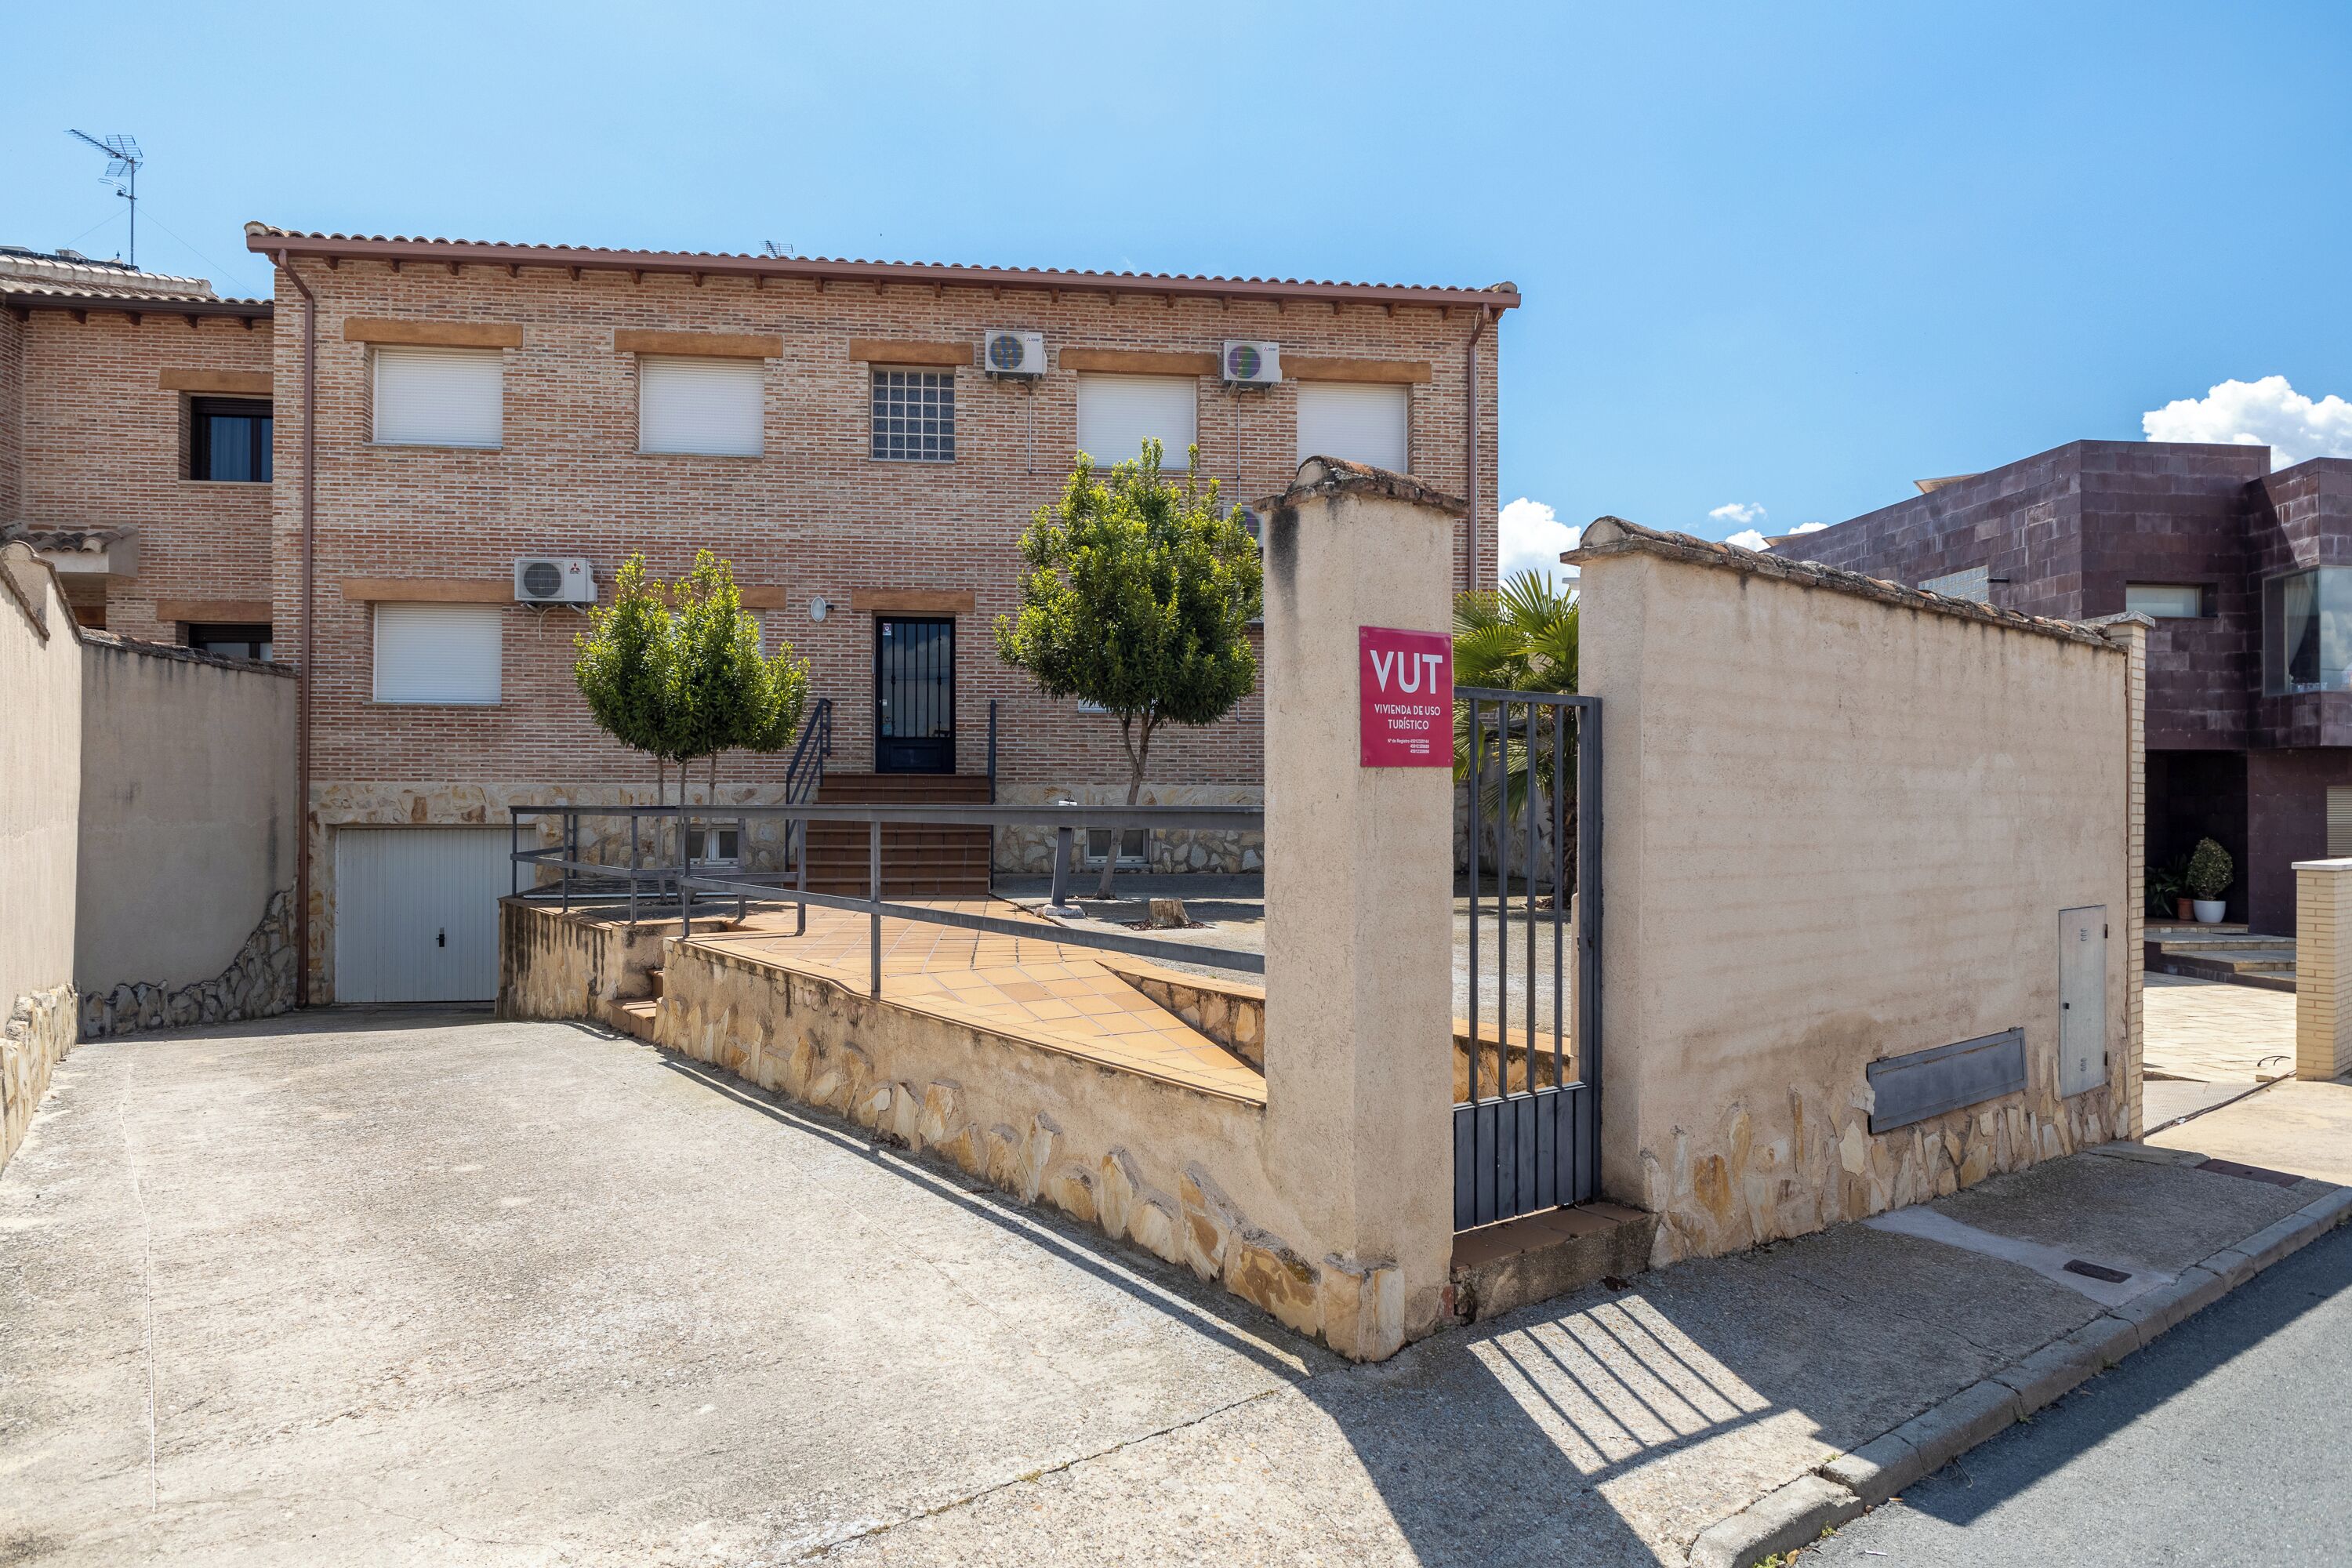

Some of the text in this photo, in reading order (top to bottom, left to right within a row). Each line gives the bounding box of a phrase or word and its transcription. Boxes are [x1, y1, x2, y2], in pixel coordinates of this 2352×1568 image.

[1370, 650, 1443, 694] VUT
[1374, 703, 1441, 716] VIVIENDA DE USO
[1388, 717, 1429, 730] TURÍSTICO
